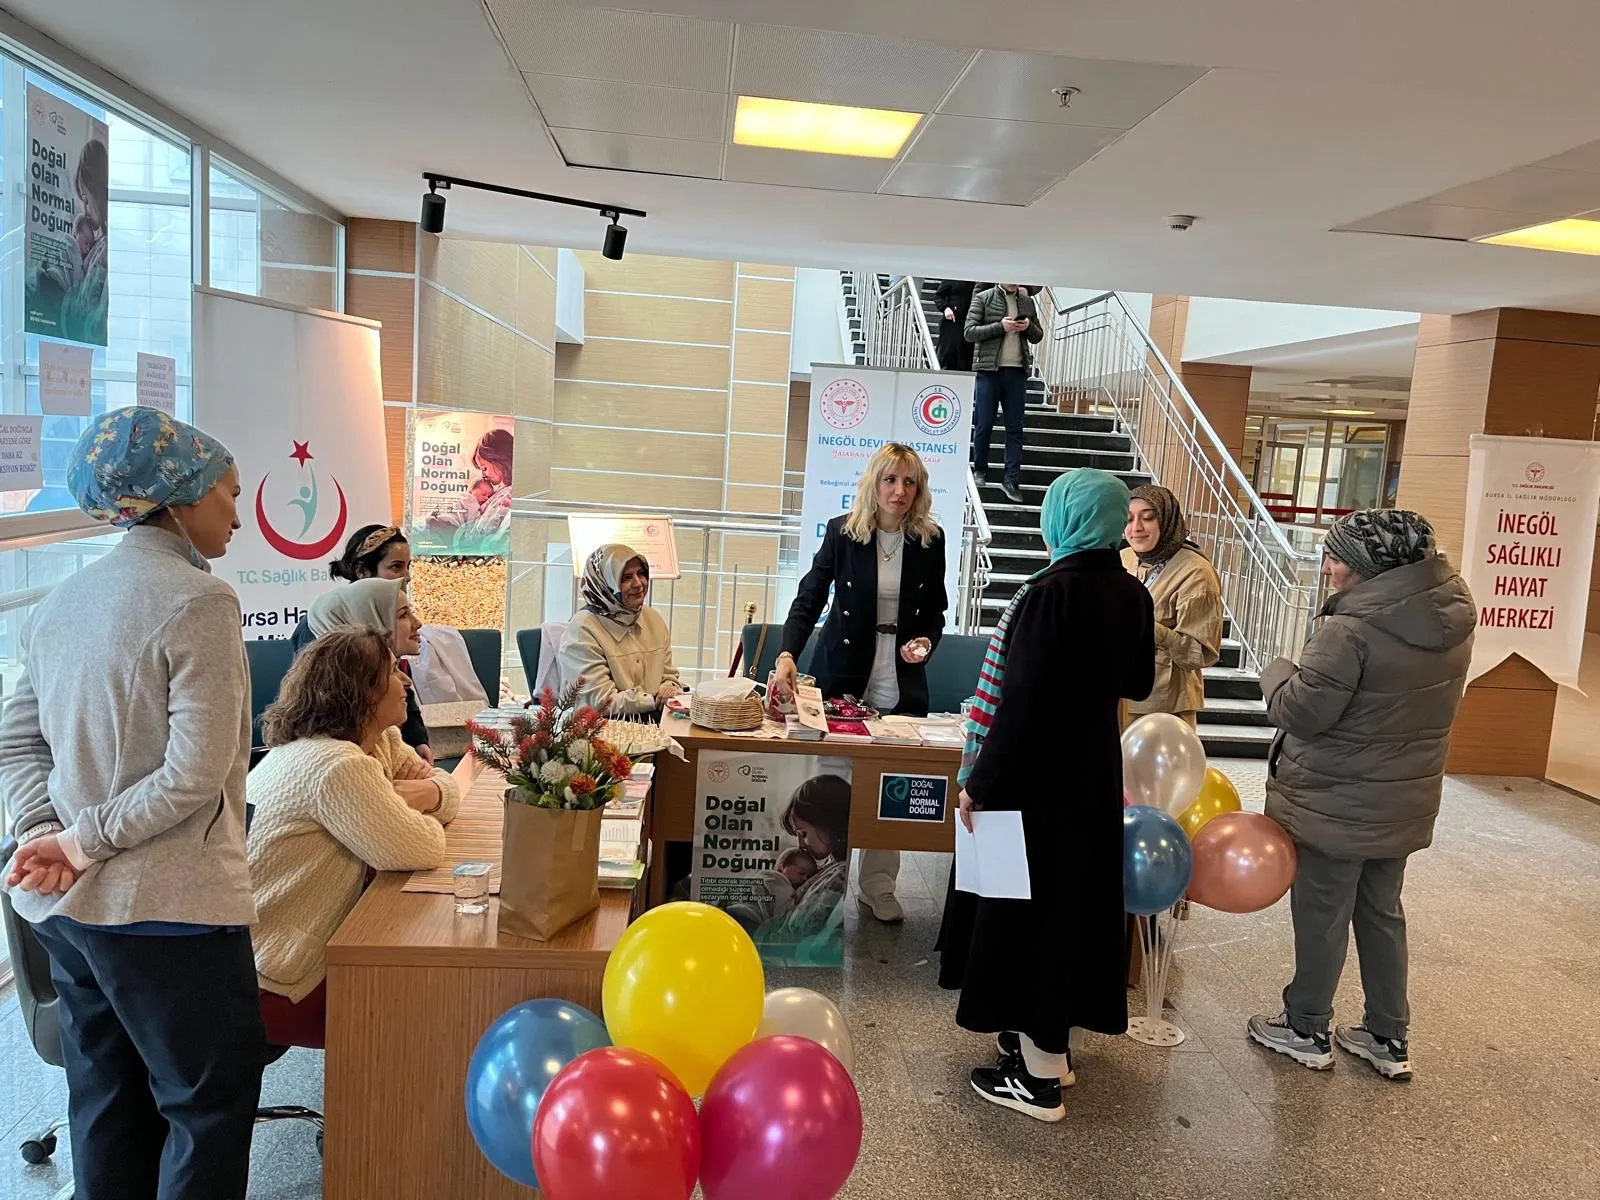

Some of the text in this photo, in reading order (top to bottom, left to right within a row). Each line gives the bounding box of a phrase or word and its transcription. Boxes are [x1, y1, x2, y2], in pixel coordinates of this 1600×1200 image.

[32, 138, 66, 170] Doğal
[32, 161, 60, 188] Olan
[32, 183, 75, 215] Normal
[32, 205, 74, 233] Doğum
[422, 441, 460, 456] Doğal
[818, 435, 857, 447] İNEGÖL
[421, 455, 453, 467] Olan
[421, 468, 470, 480] Normal
[420, 481, 468, 494] Doğum
[1497, 508, 1559, 536] İNEGÖL
[1486, 541, 1562, 567] SAĞLIKLI
[262, 568, 307, 586] Sağlık
[1494, 575, 1548, 597] HAYAT
[1480, 605, 1555, 630] MERKEZİ
[910, 788, 929, 797] OLAN
[911, 779, 935, 789] DOĞAL
[705, 795, 766, 816] Doğal
[909, 797, 941, 807] NORMAL
[909, 805, 936, 815] DOĞUM
[704, 814, 753, 831] Olan
[703, 833, 780, 851] Normal
[702, 853, 777, 873] Doğum
